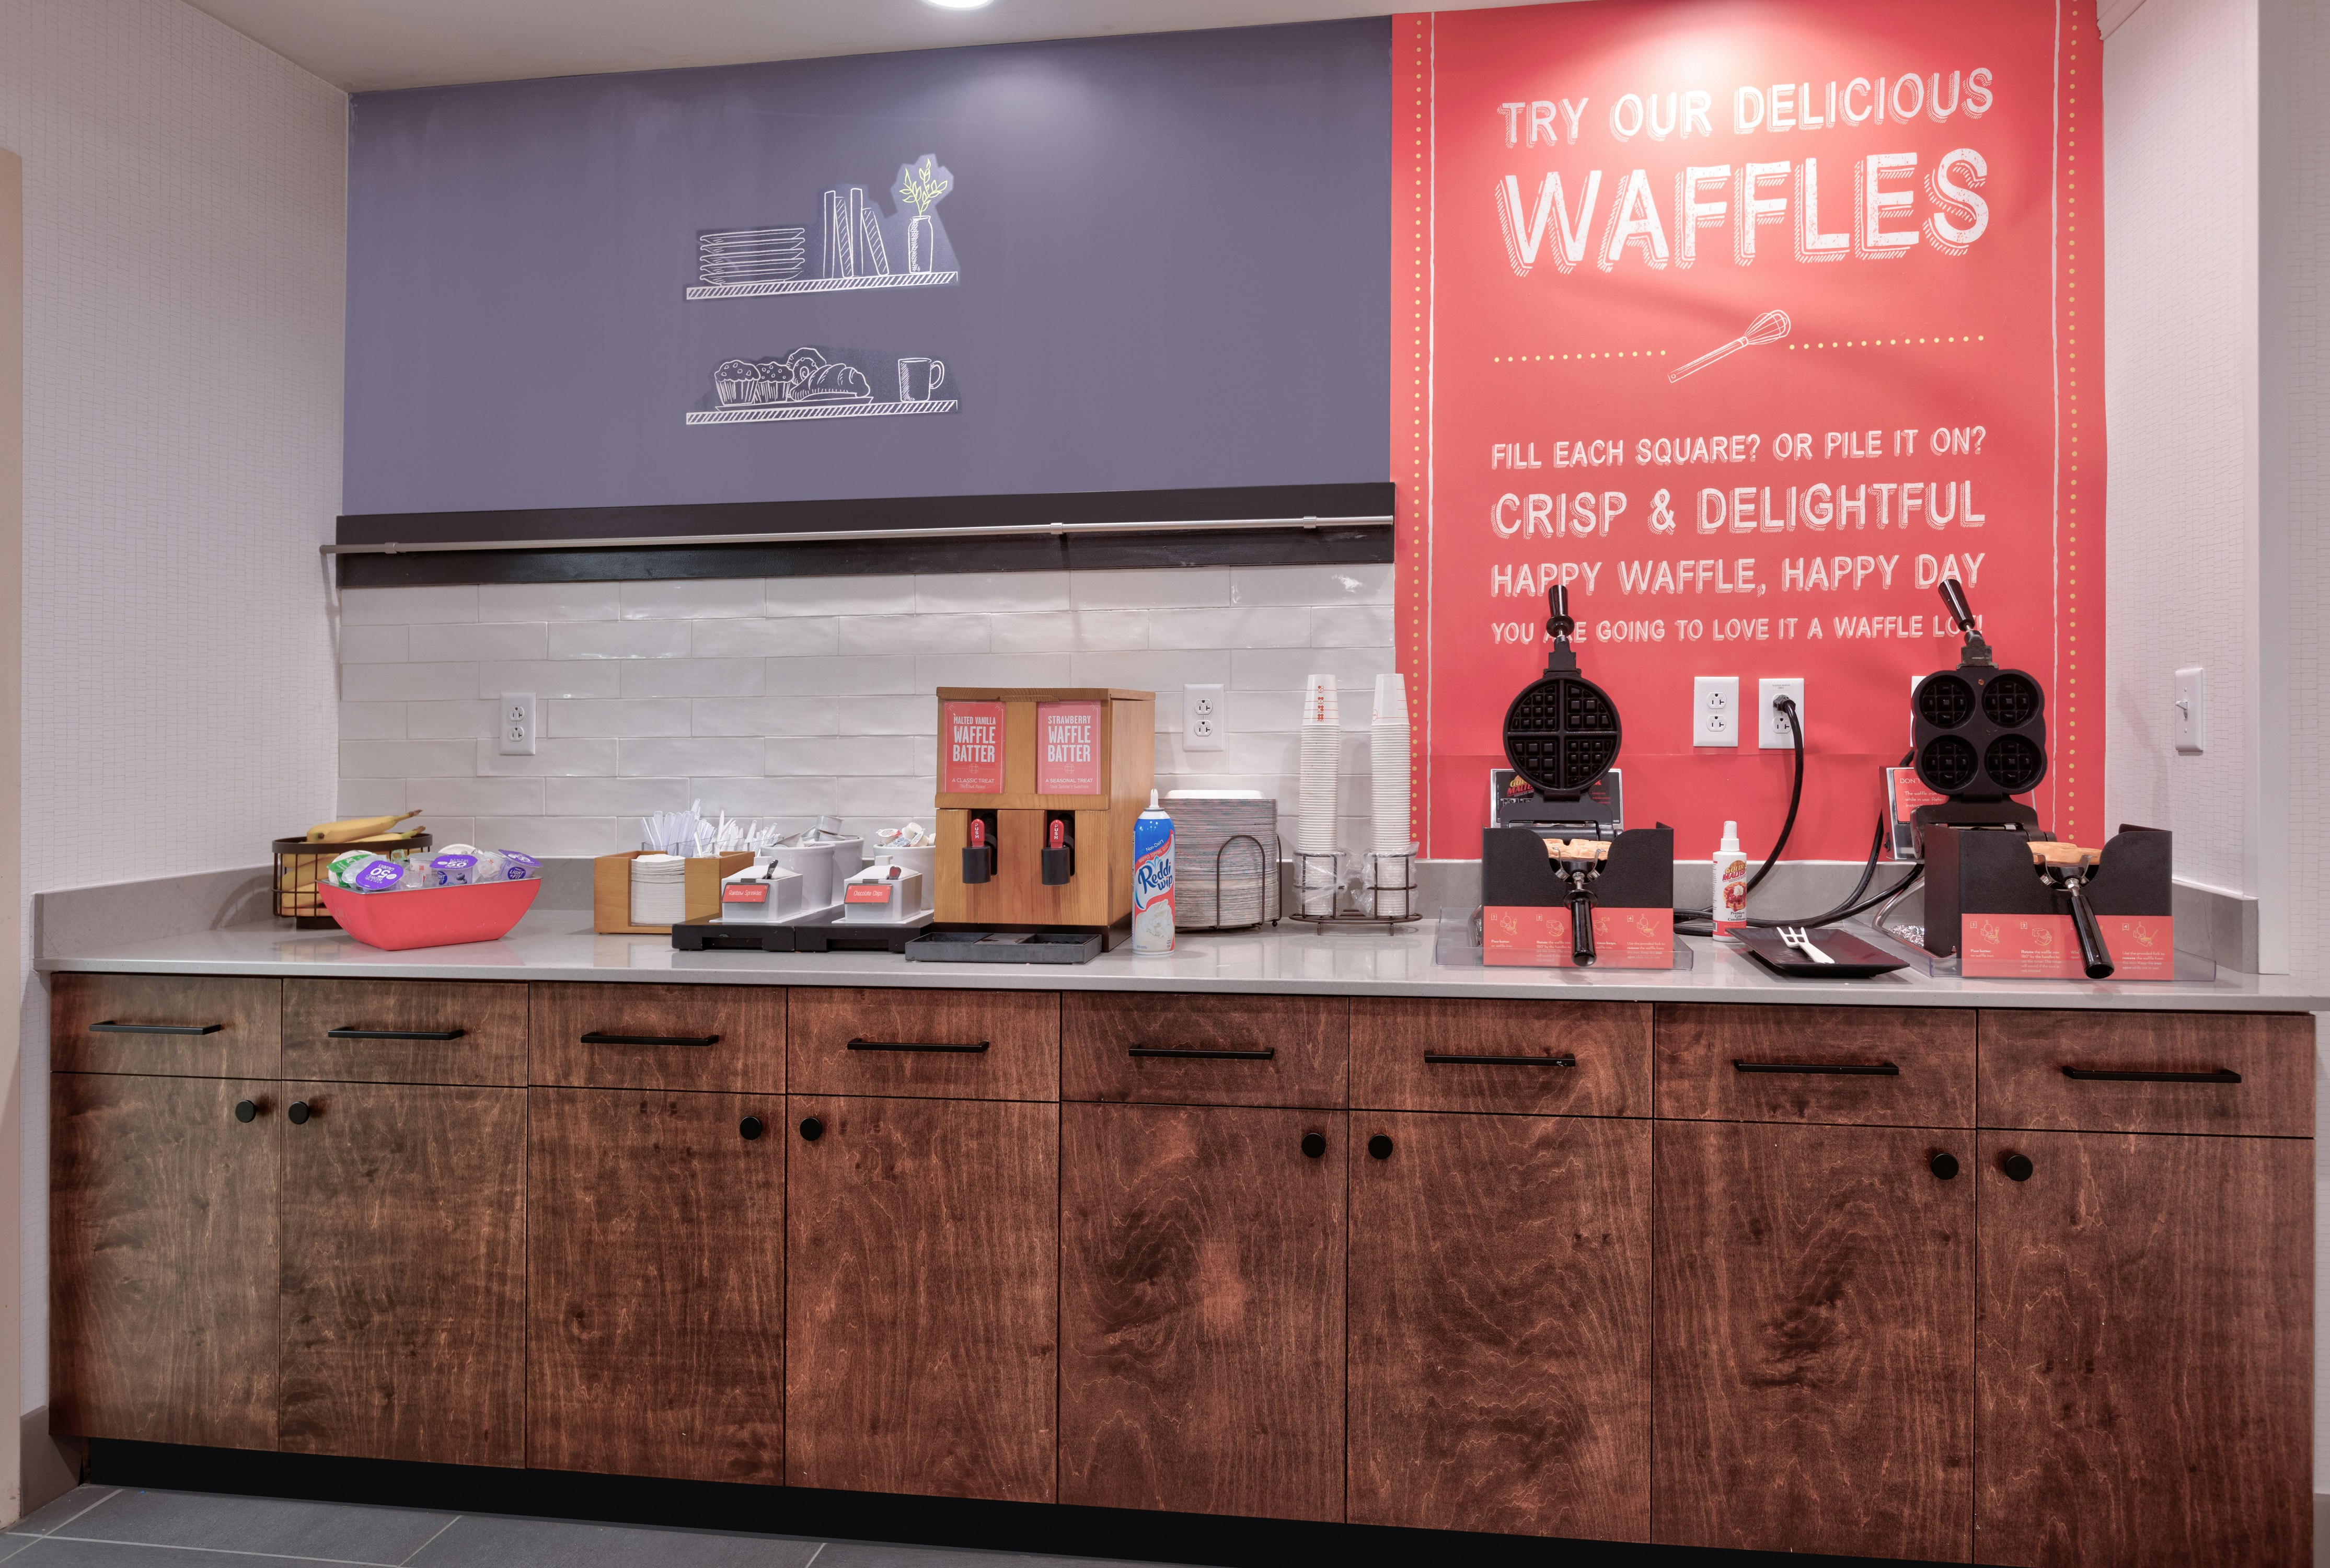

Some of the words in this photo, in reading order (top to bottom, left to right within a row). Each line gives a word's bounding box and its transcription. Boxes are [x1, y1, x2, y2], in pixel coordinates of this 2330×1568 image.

[1497, 98, 1589, 148] TRY
[1609, 89, 1713, 141] OUR
[1733, 67, 1993, 136] DELICIOUS
[1495, 147, 1989, 278] WAFFLES
[1491, 442, 1542, 470] FILL
[1553, 440, 1623, 468] EACH
[1635, 434, 1761, 467] SQUARE?
[1773, 433, 1813, 461] OR
[1825, 430, 1882, 459] PILE
[1894, 430, 1919, 457] IT
[1930, 425, 1986, 456] ON?
[1490, 491, 1627, 540] CRISP
[1647, 488, 1677, 536] &
[1697, 480, 1986, 535] DELIGHTFUL
[1491, 561, 1602, 597] HAPPY
[1617, 558, 1766, 597] WAFFLE,
[1782, 555, 1899, 592] HAPPY
[1915, 552, 1986, 589] DAY
[1491, 622, 1534, 644] YOU
[1596, 620, 1665, 643] GOING
[1675, 618, 1703, 641] TO
[1713, 618, 1769, 641] LOVE
[1779, 618, 1798, 639] IT
[1807, 617, 1823, 639] A
[1833, 615, 1923, 639] WAFFLE
[1933, 615, 1982, 637] LO!
[975, 717, 996, 725] VANILLA
[1048, 716, 1091, 724] STRAWBERRY
[954, 725, 996, 744] WAFFLE
[1048, 725, 1091, 743] WAFFLE
[953, 744, 995, 762] BATTER
[1048, 744, 1090, 762] BATTER
[1146, 839, 1164, 852] Non-Dairy
[1138, 854, 1150, 863] WHIPPED
[1150, 849, 1163, 857] TOPPING
[370, 868, 391, 878] 50
[1138, 858, 1171, 894] Reddi
[1157, 875, 1173, 891] wip
